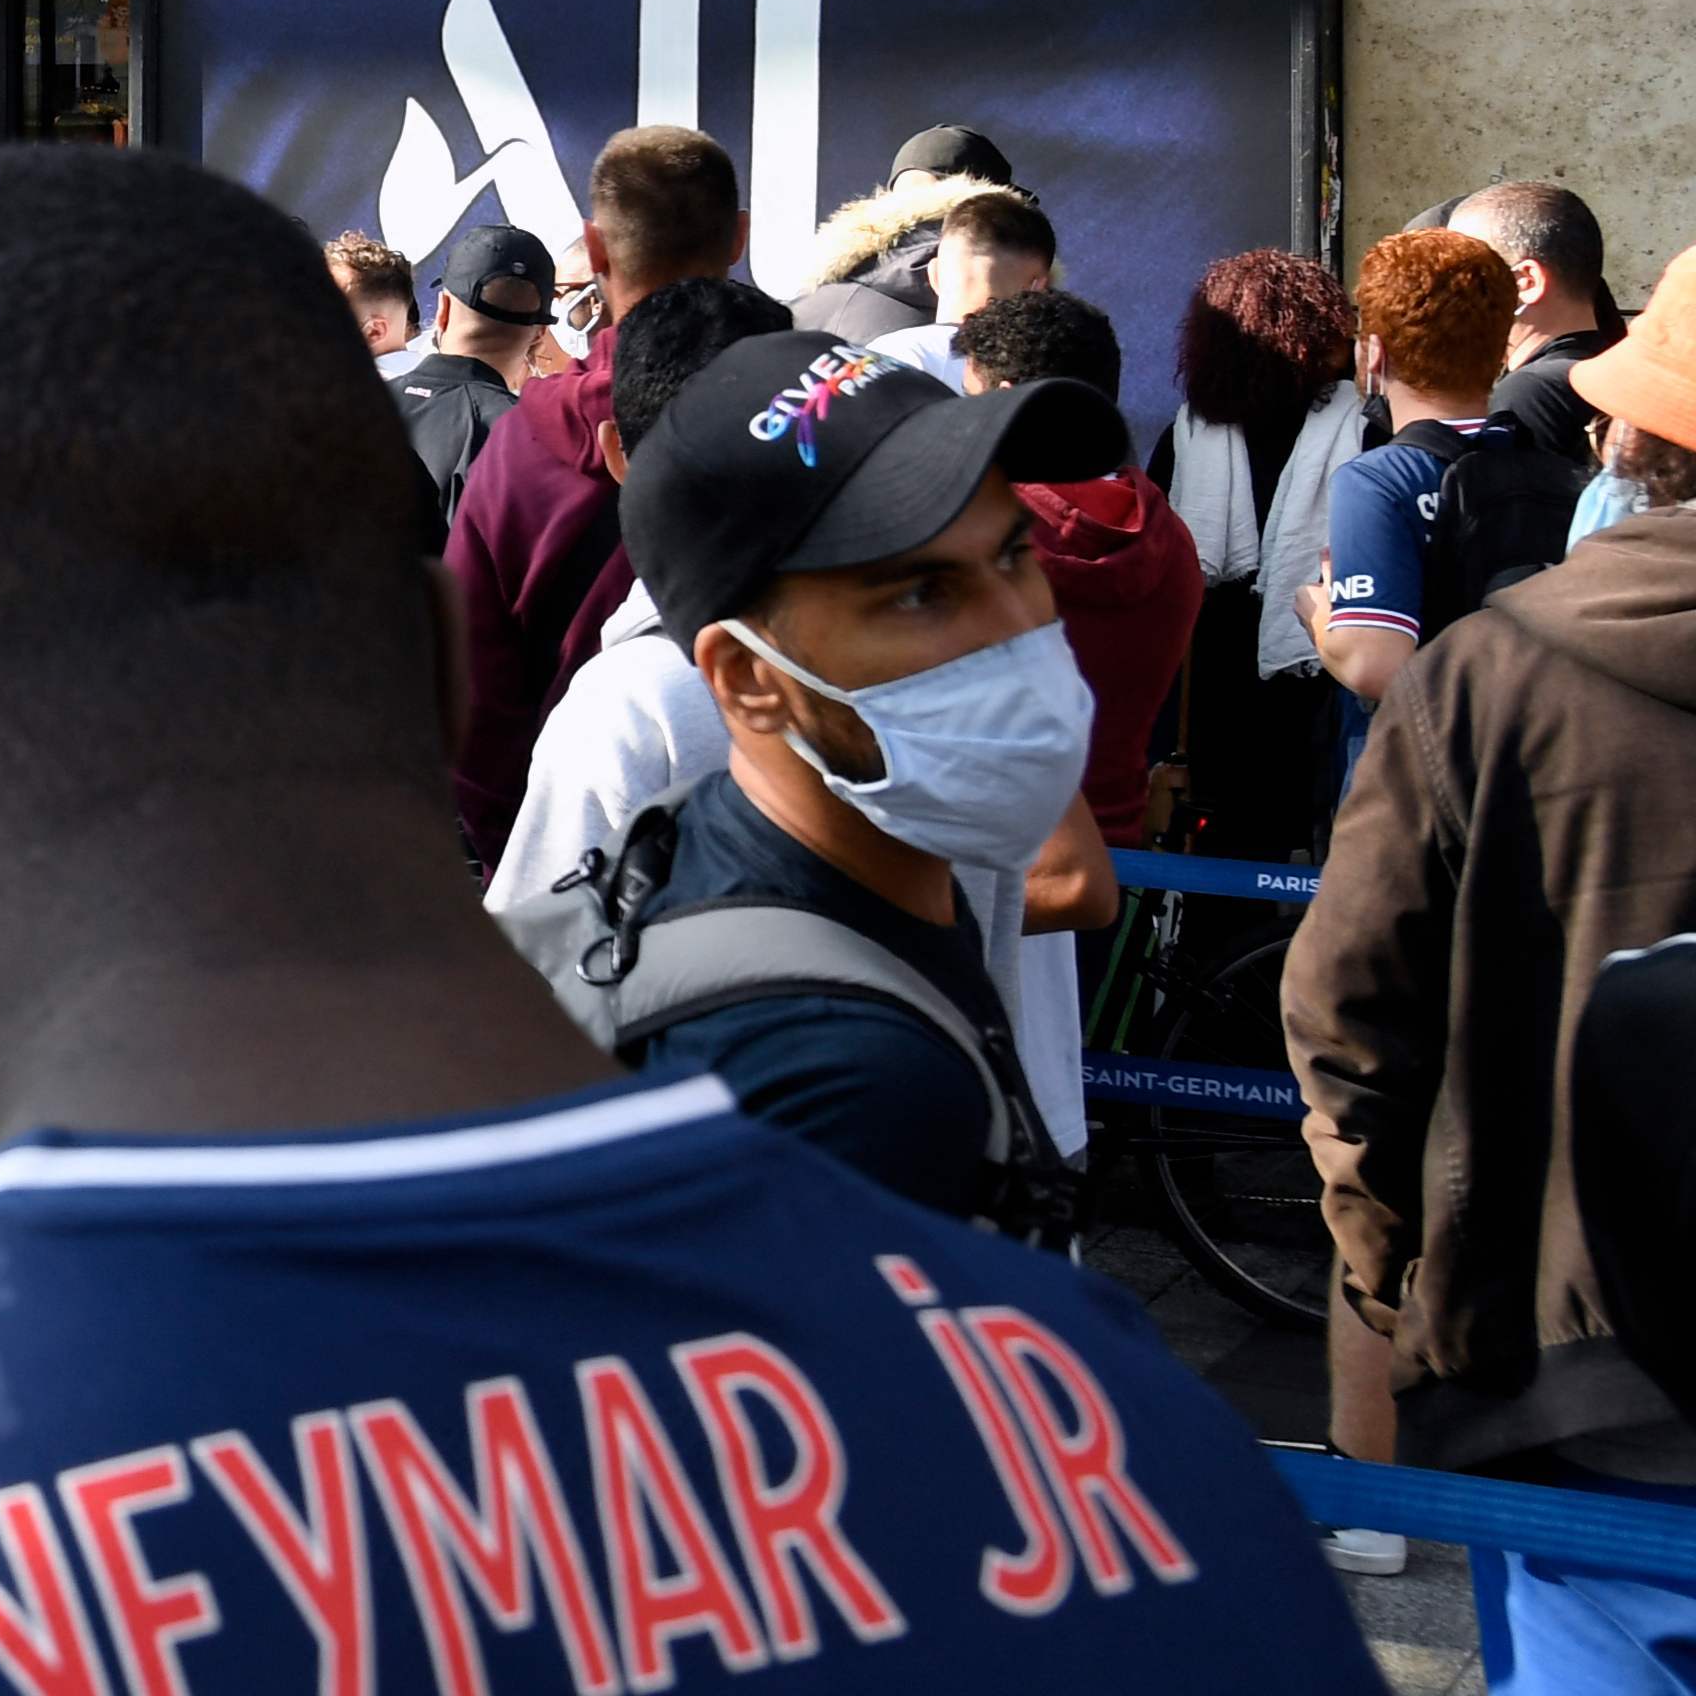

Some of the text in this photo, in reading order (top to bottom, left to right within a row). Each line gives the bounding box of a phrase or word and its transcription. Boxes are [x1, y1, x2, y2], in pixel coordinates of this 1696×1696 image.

[1328, 574, 1375, 602] NB
[1257, 873, 1322, 894] PARIS
[1082, 1066, 1294, 1105] SAINT-GERMAIN
